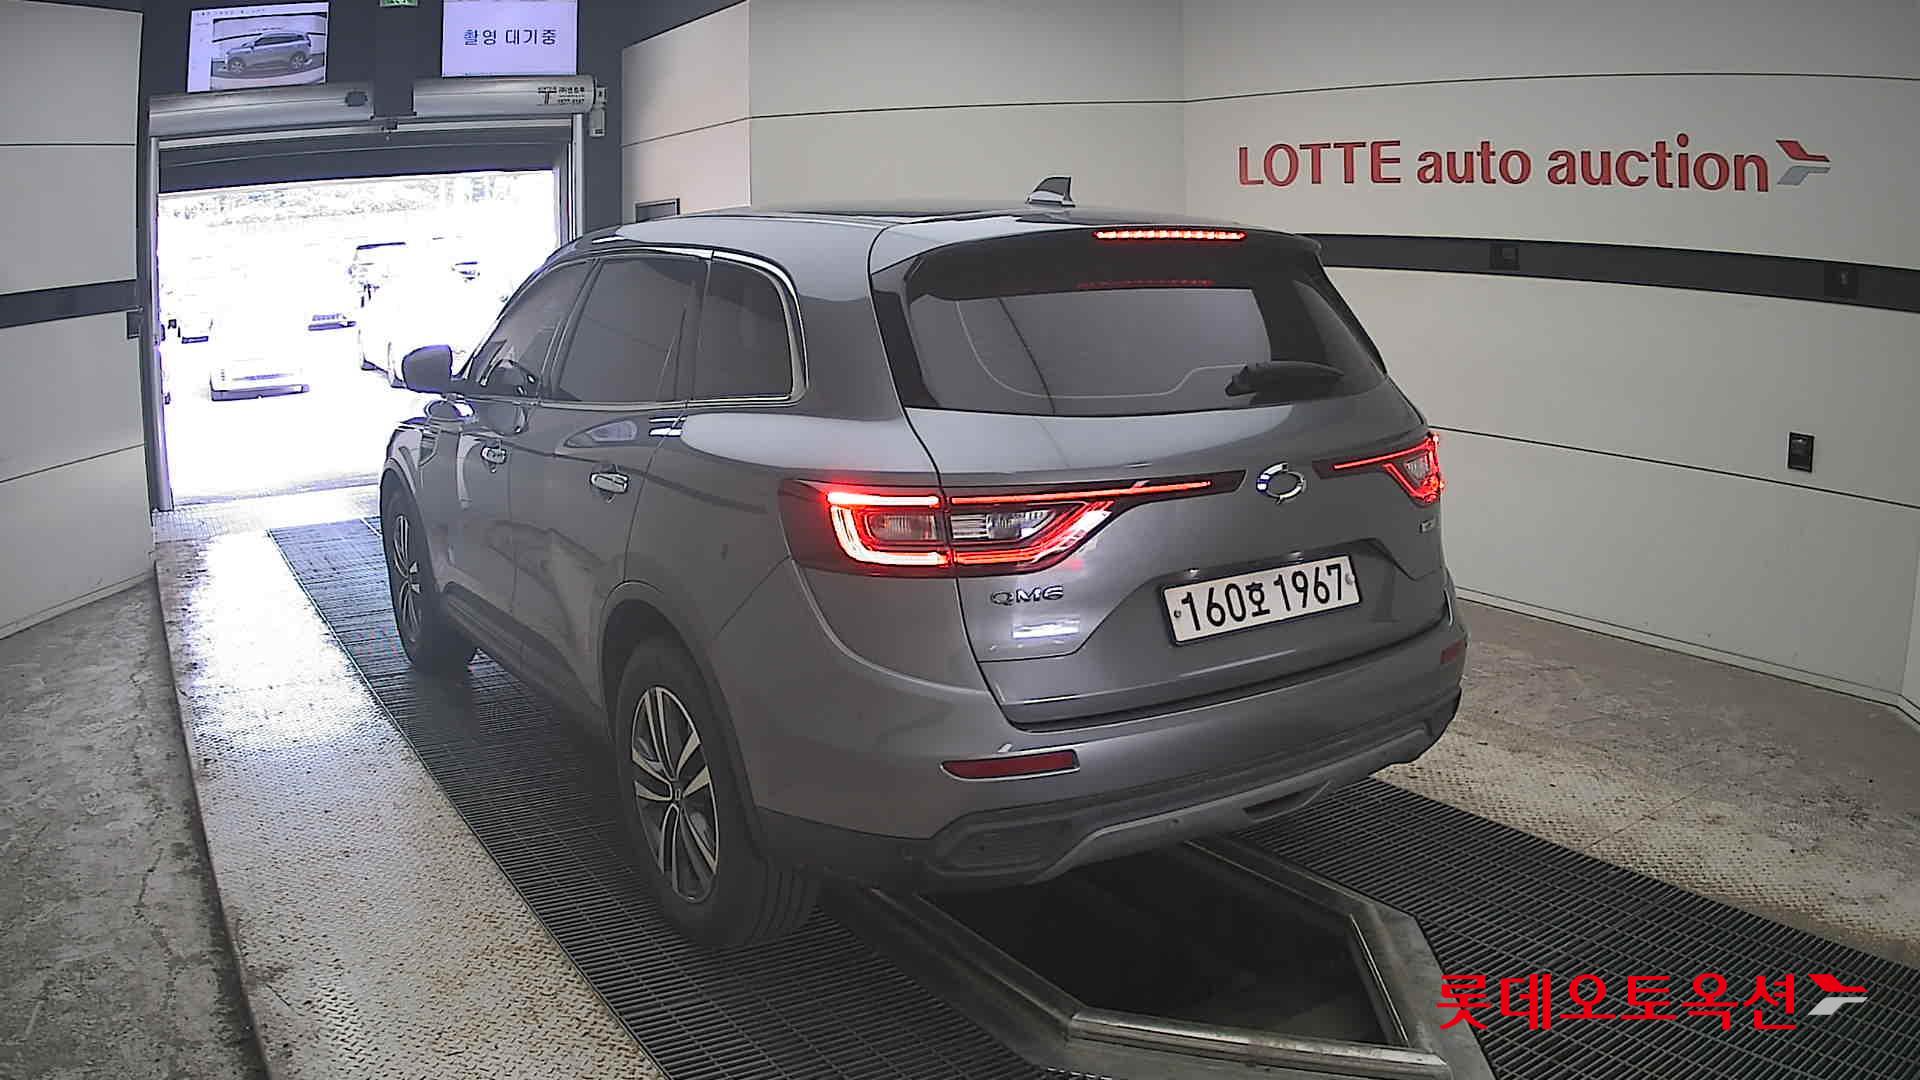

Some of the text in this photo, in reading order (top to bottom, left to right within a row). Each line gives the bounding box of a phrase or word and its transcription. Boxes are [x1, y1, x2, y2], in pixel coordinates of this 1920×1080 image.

[505, 29, 556, 45] 대기중
[1239, 133, 1769, 192] LOTTE auto auction
[991, 584, 1064, 606] QM6
